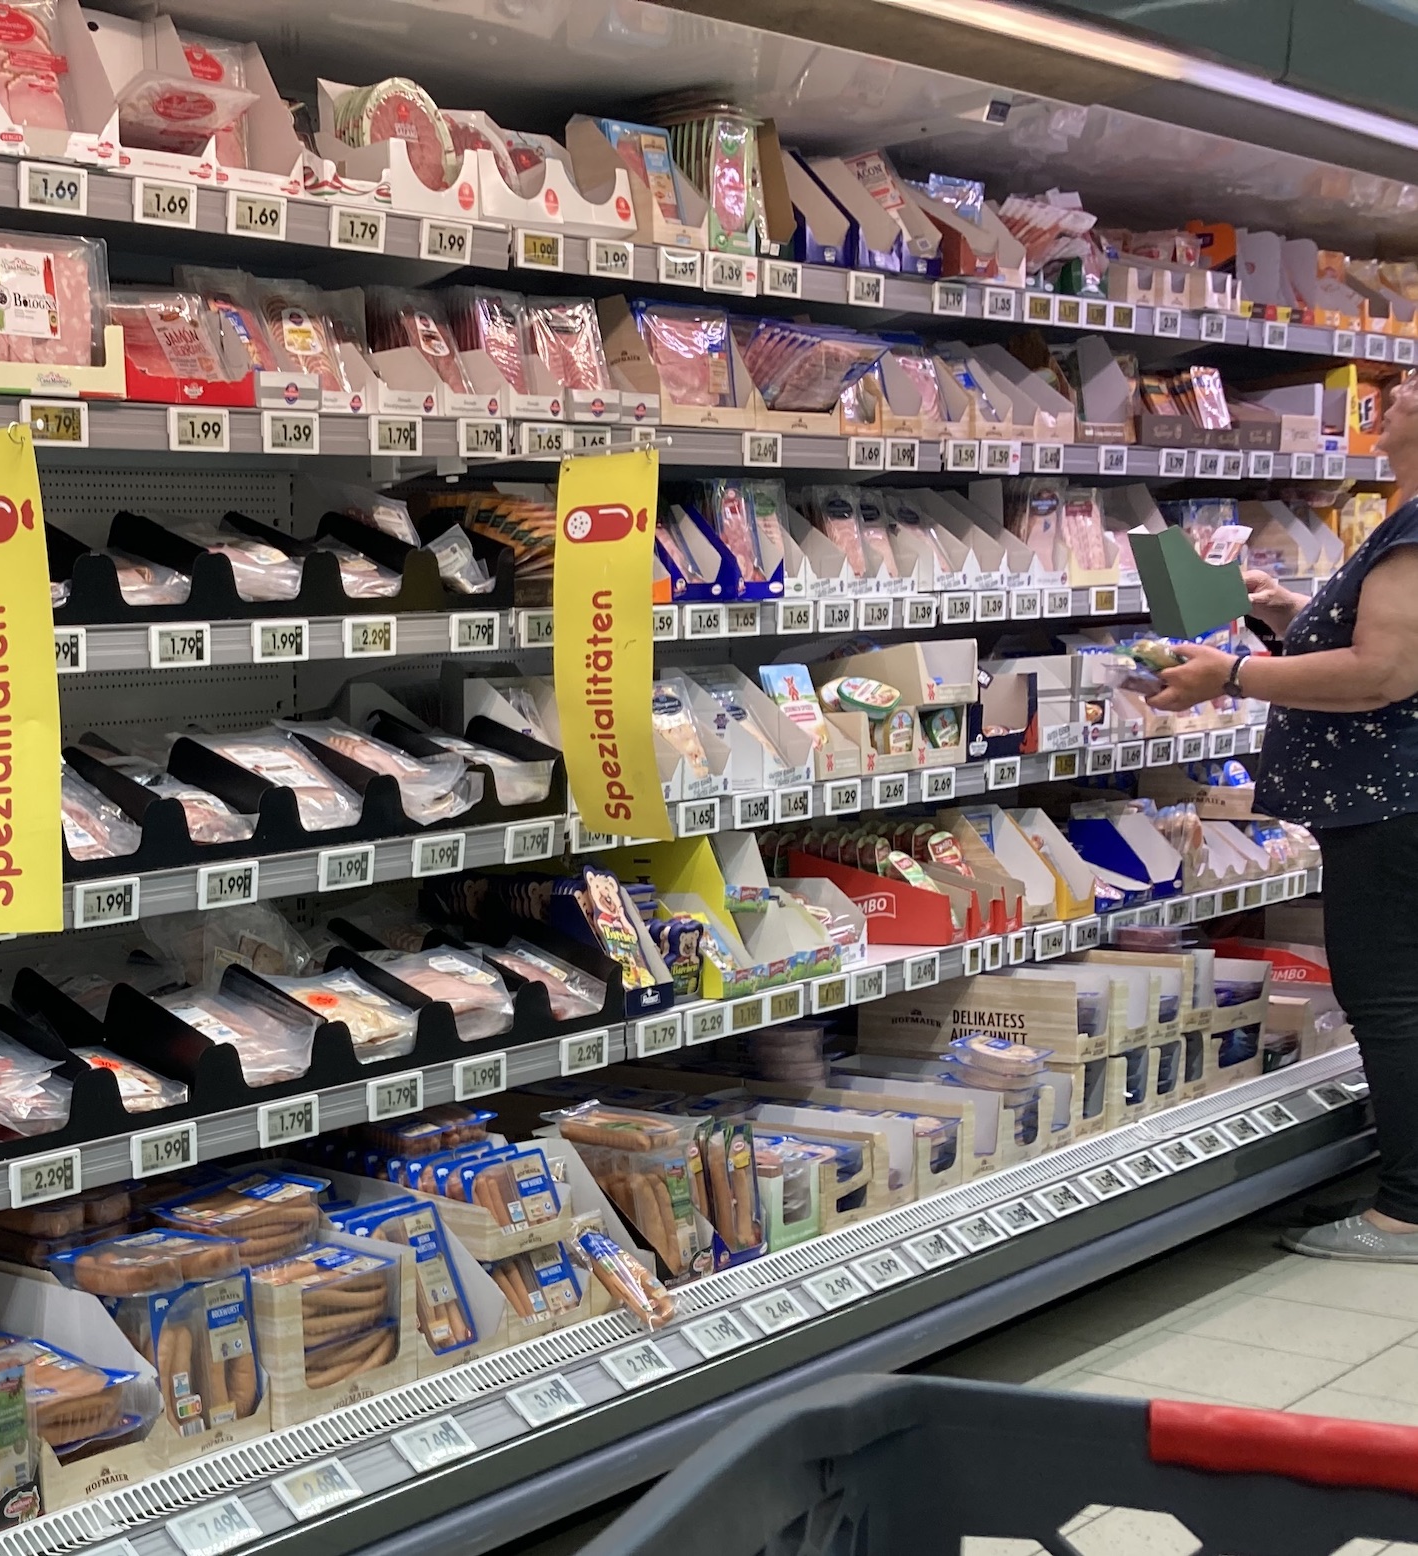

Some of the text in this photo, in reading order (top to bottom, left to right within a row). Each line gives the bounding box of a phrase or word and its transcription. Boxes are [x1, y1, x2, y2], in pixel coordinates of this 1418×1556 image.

[42, 178, 78, 201] 1.69
[155, 193, 188, 216] 1.69
[247, 206, 279, 227] 1.69
[350, 221, 378, 240] 1.79
[439, 232, 465, 252] 1.99
[719, 266, 741, 281] 1.39
[189, 422, 221, 440] 1.99
[282, 425, 311, 442] 1.39
[388, 428, 410, 444] 1.79
[475, 430, 495, 446] 1.79
[537, 434, 561, 450] 1.65
[756, 442, 773, 457] 2.69
[861, 446, 879, 460] 1.69
[697, 614, 719, 628] 1.65
[735, 612, 756, 626] 1.65
[788, 610, 808, 624] 1.65
[830, 610, 850, 623] 1.39
[870, 608, 889, 621] 1.39
[914, 606, 932, 619] 1.39
[362, 629, 384, 646] 2.29
[466, 625, 488, 641] 1.79
[171, 637, 195, 655] 1.79
[272, 634, 296, 650] 1.99
[585, 590, 631, 821] Spezialitäten
[886, 784, 903, 798] 2.69
[934, 777, 951, 791] 2.69
[837, 790, 856, 804] 1.29
[522, 835, 542, 852] 1.79
[430, 848, 452, 865] 1.99
[337, 861, 361, 878] 1.99
[219, 876, 244, 895] 1.99
[96, 894, 124, 913] 1.99
[701, 1017, 723, 1032] 2.29
[952, 1009, 1025, 1029] DELIKATESS
[652, 1027, 675, 1045] 1.79
[577, 1044, 598, 1061] 2.29
[472, 1067, 495, 1085] 1.99
[387, 1087, 410, 1104] 1.79
[280, 1113, 304, 1131] 1.79
[154, 1141, 182, 1161] 1.99
[35, 1166, 63, 1190] 2.29
[872, 1258, 898, 1277] 1.99
[827, 1277, 853, 1297] 2.99
[631, 1356, 653, 1375] 2.79
[333, 1389, 374, 1411] HOFMAIER
[539, 1389, 561, 1409] 3.19
[85, 1472, 129, 1495] HOFMAIER
[304, 1477, 332, 1497] 2.69
